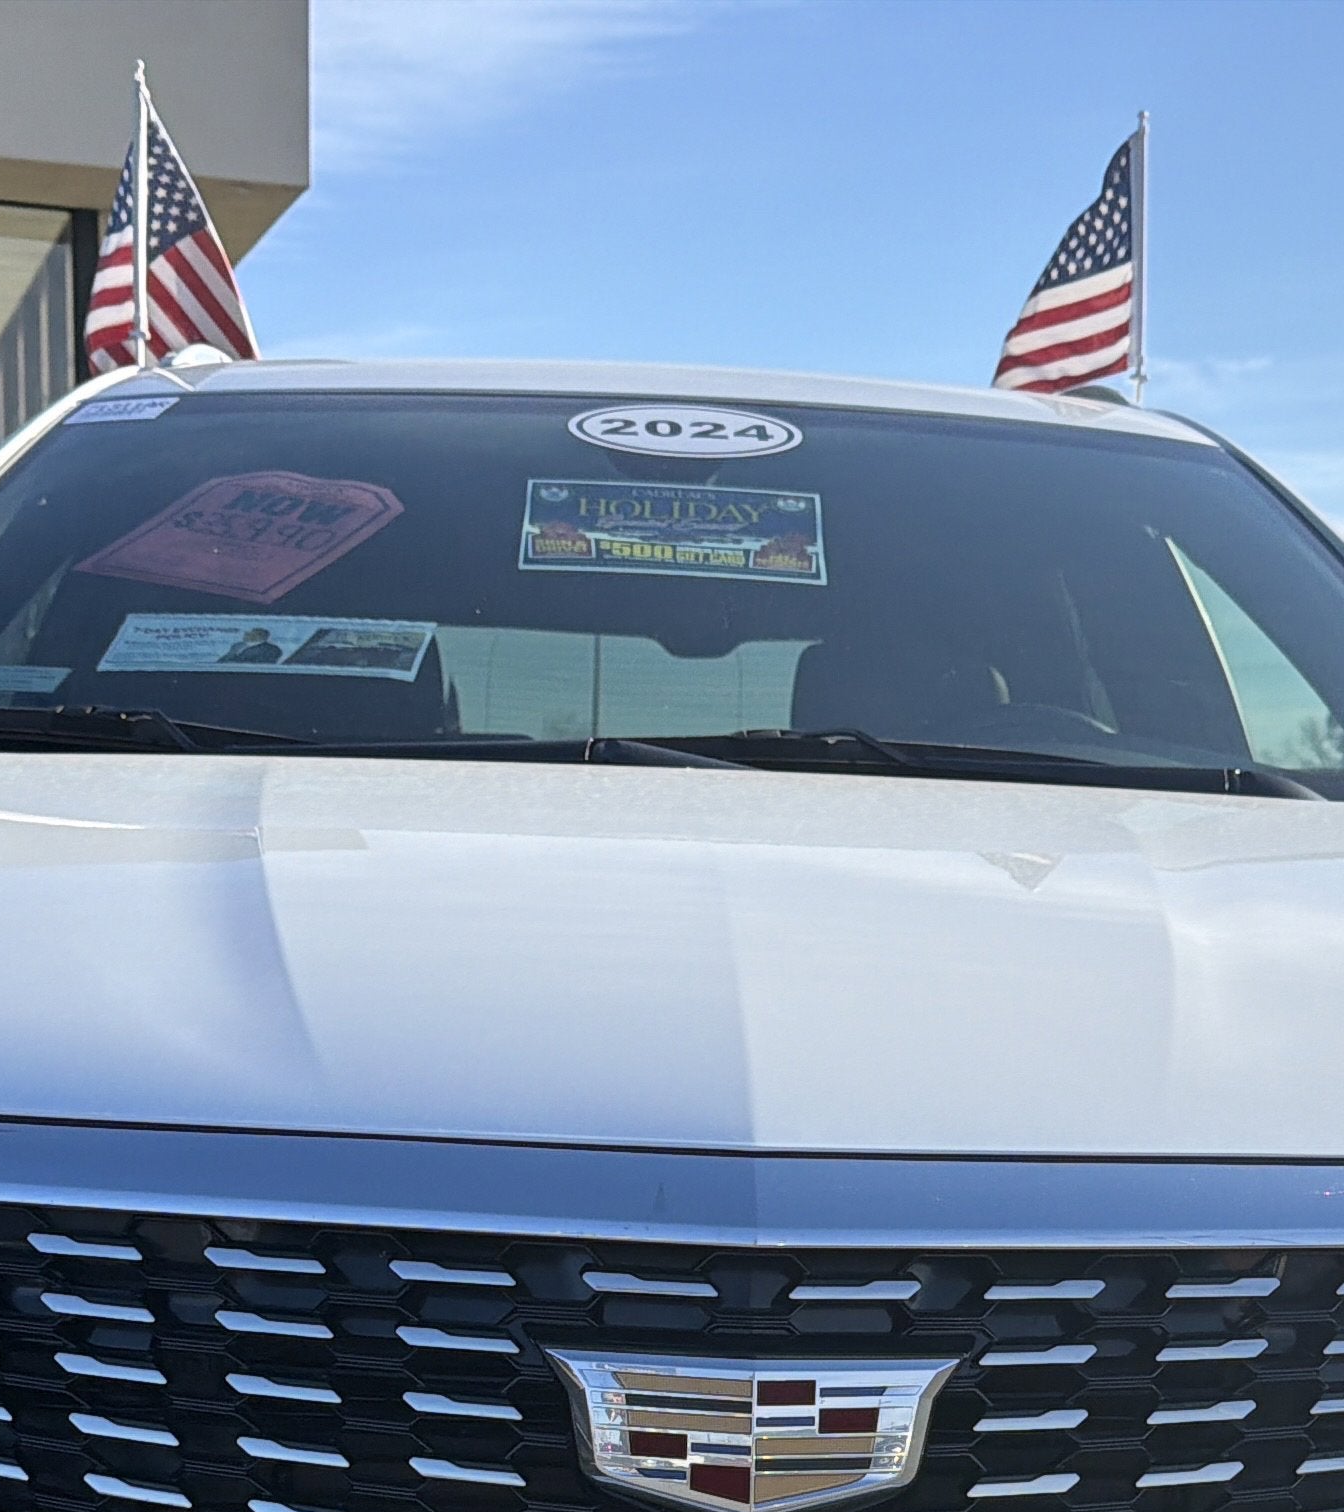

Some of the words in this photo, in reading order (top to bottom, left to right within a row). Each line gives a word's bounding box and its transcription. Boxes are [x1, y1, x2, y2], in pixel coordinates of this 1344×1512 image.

[600, 418, 774, 442] 2024
[222, 489, 354, 526] NOW
[578, 497, 766, 523] HOLIDAY
[599, 540, 674, 559] $500
